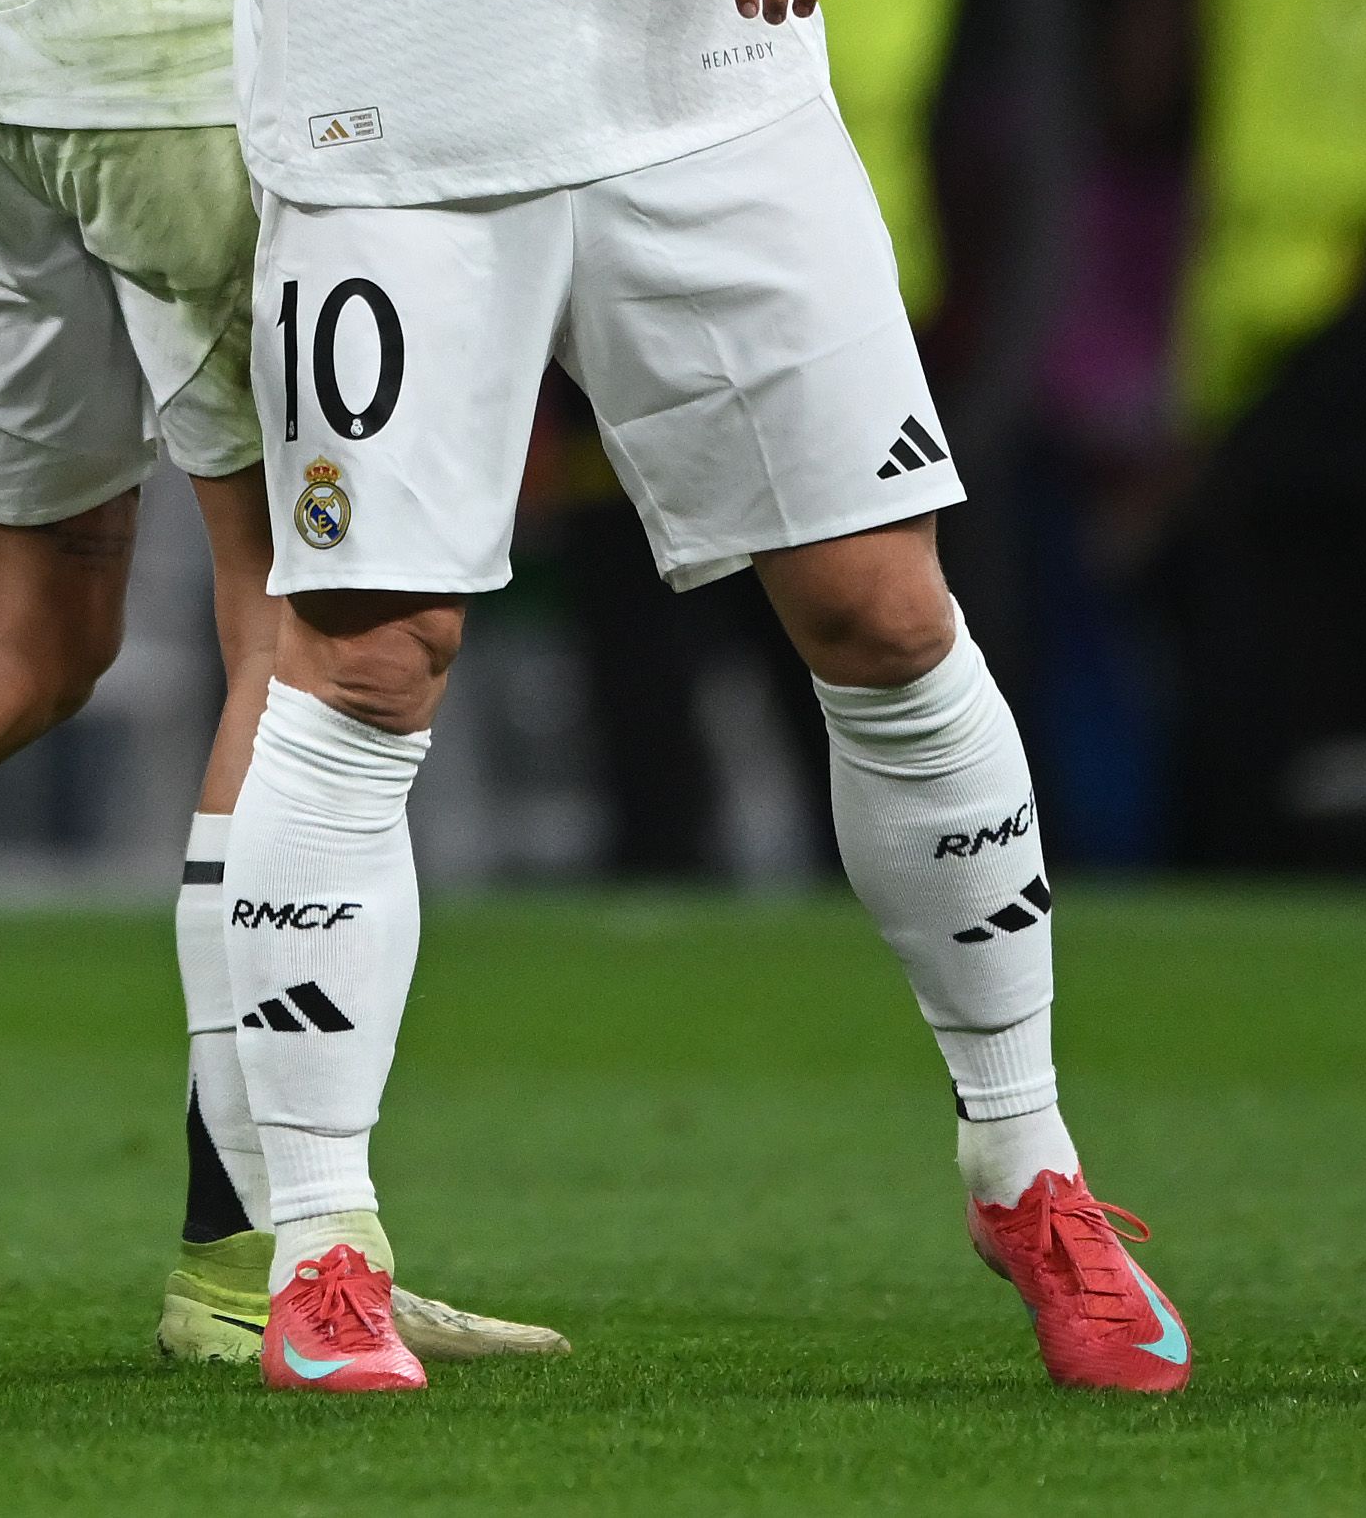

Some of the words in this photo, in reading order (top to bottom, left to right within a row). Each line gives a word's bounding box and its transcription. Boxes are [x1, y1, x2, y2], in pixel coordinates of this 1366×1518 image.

[701, 41, 774, 70] HEAT.RDY
[276, 277, 405, 443] 10
[231, 898, 363, 930] RMCF
